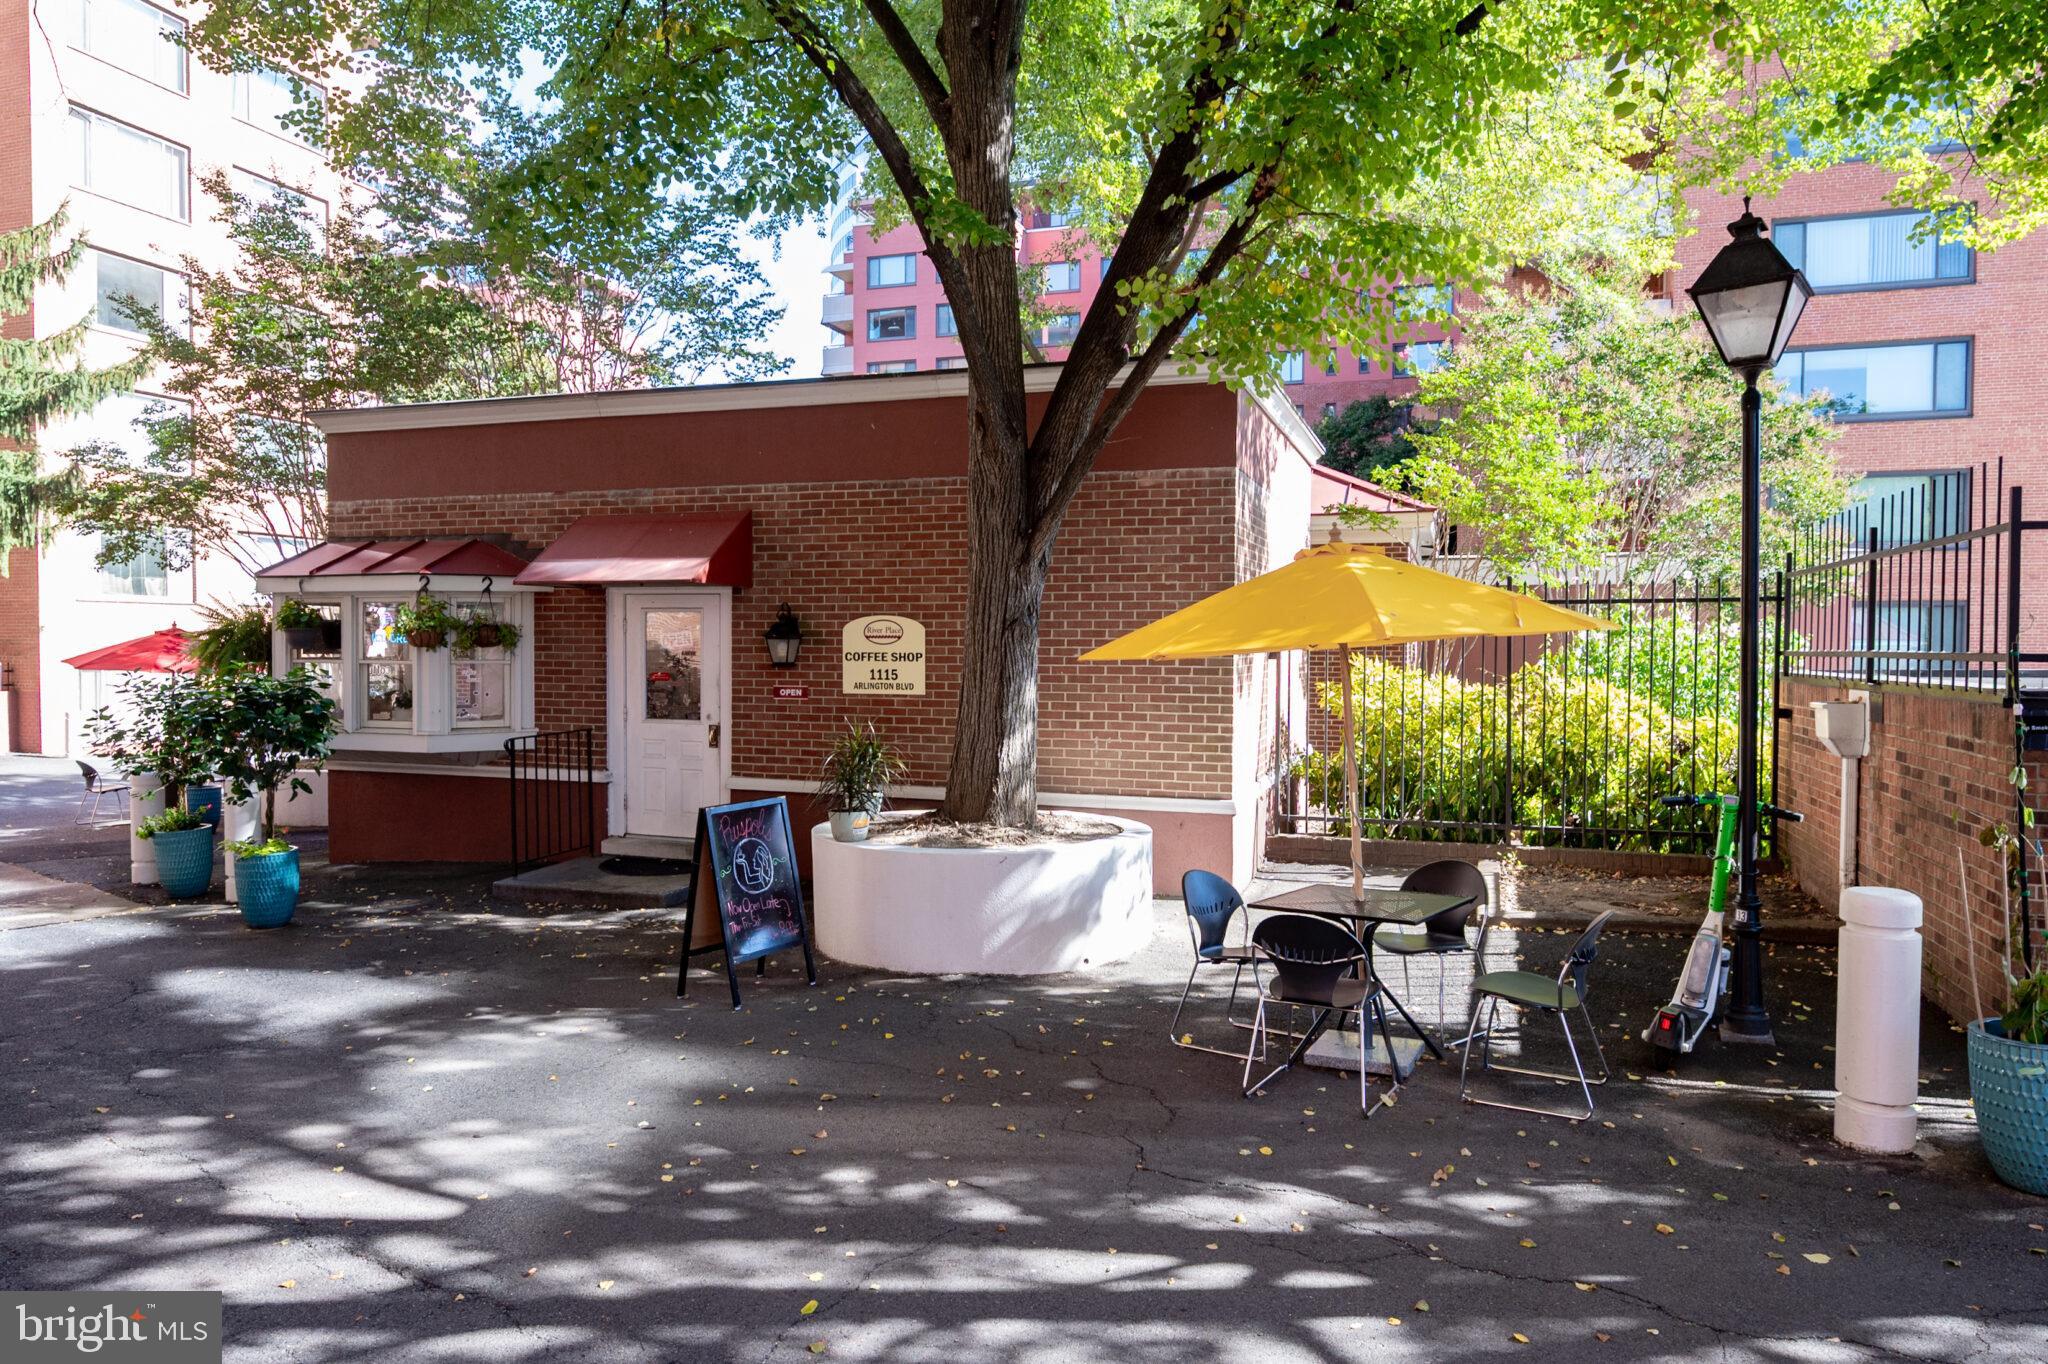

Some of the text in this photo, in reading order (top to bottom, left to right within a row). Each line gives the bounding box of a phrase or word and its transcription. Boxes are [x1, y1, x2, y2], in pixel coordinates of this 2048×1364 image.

[867, 626, 901, 634] River Place
[844, 651, 923, 662] COFFEE SHOP
[869, 668, 898, 680] 1115
[853, 682, 914, 691] ARLINGTON BLVD
[779, 688, 802, 697] OPEN
[727, 895, 781, 921] Now Open Late
